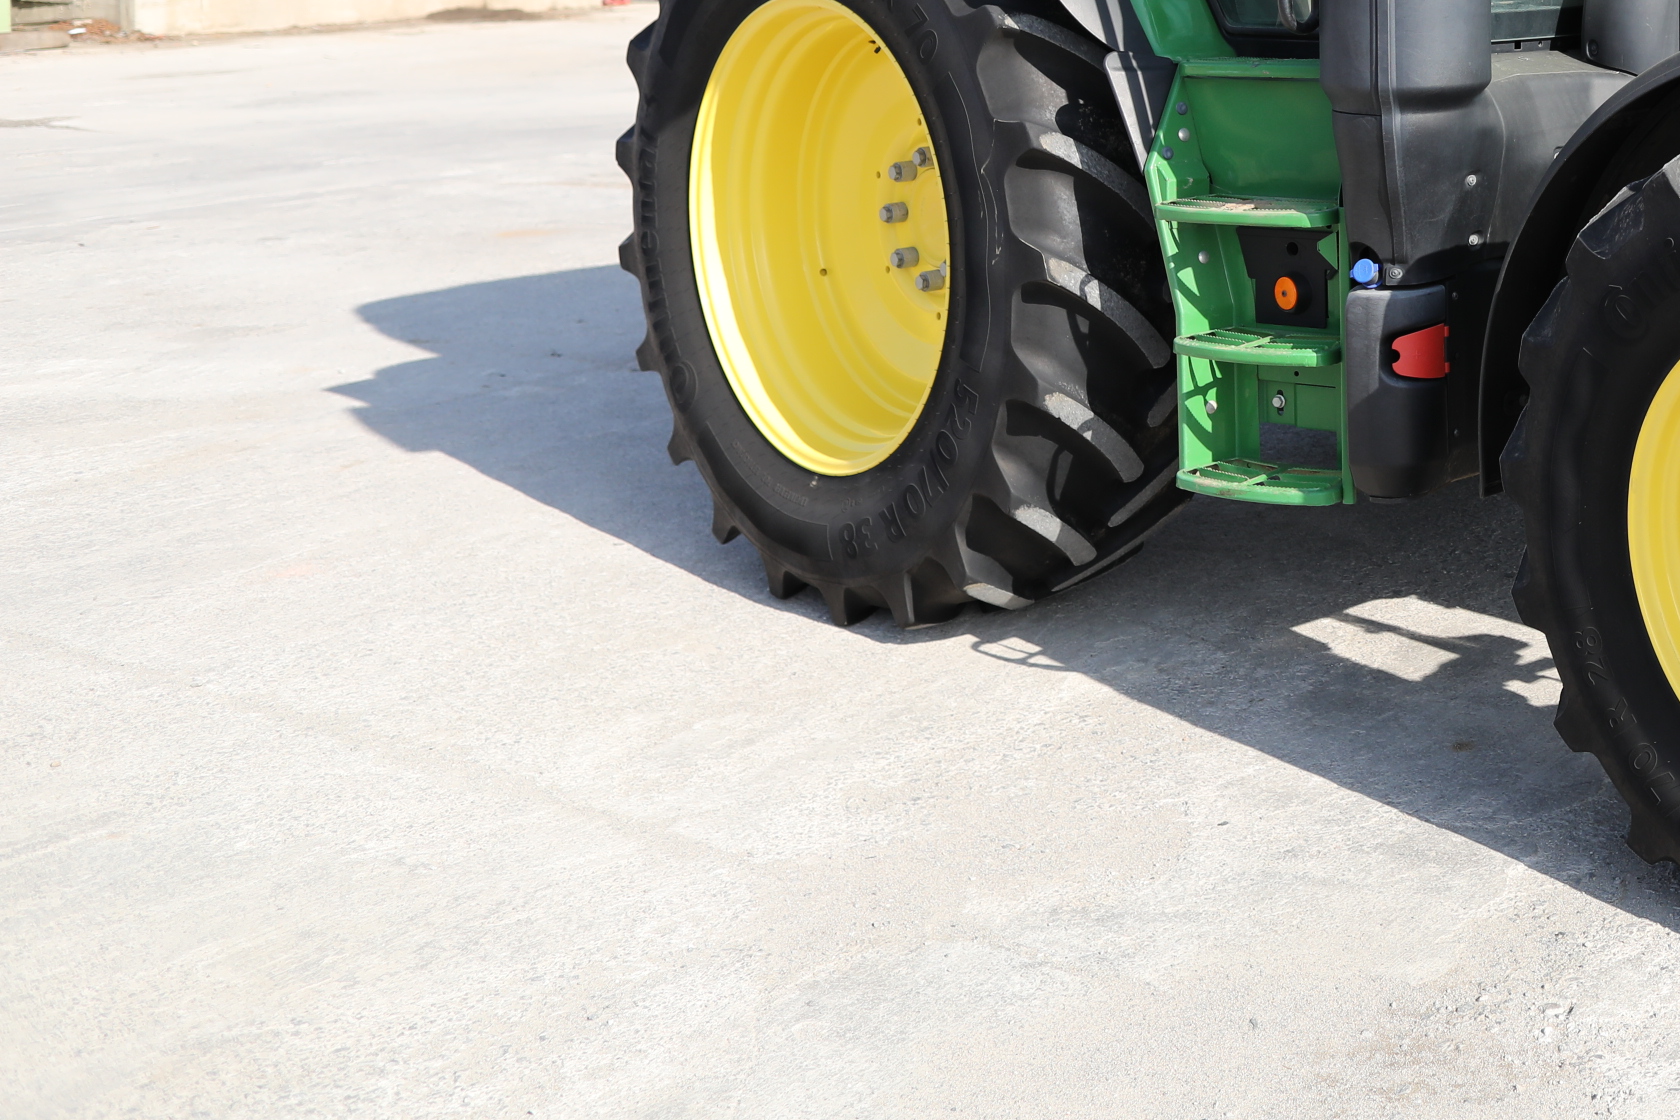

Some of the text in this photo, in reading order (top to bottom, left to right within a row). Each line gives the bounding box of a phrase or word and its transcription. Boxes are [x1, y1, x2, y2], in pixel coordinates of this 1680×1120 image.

[902, 3, 940, 67] 70
[902, 375, 981, 520] 520/70
[838, 520, 880, 562] 38
[874, 503, 907, 543] R
[1571, 624, 1608, 688] 28
